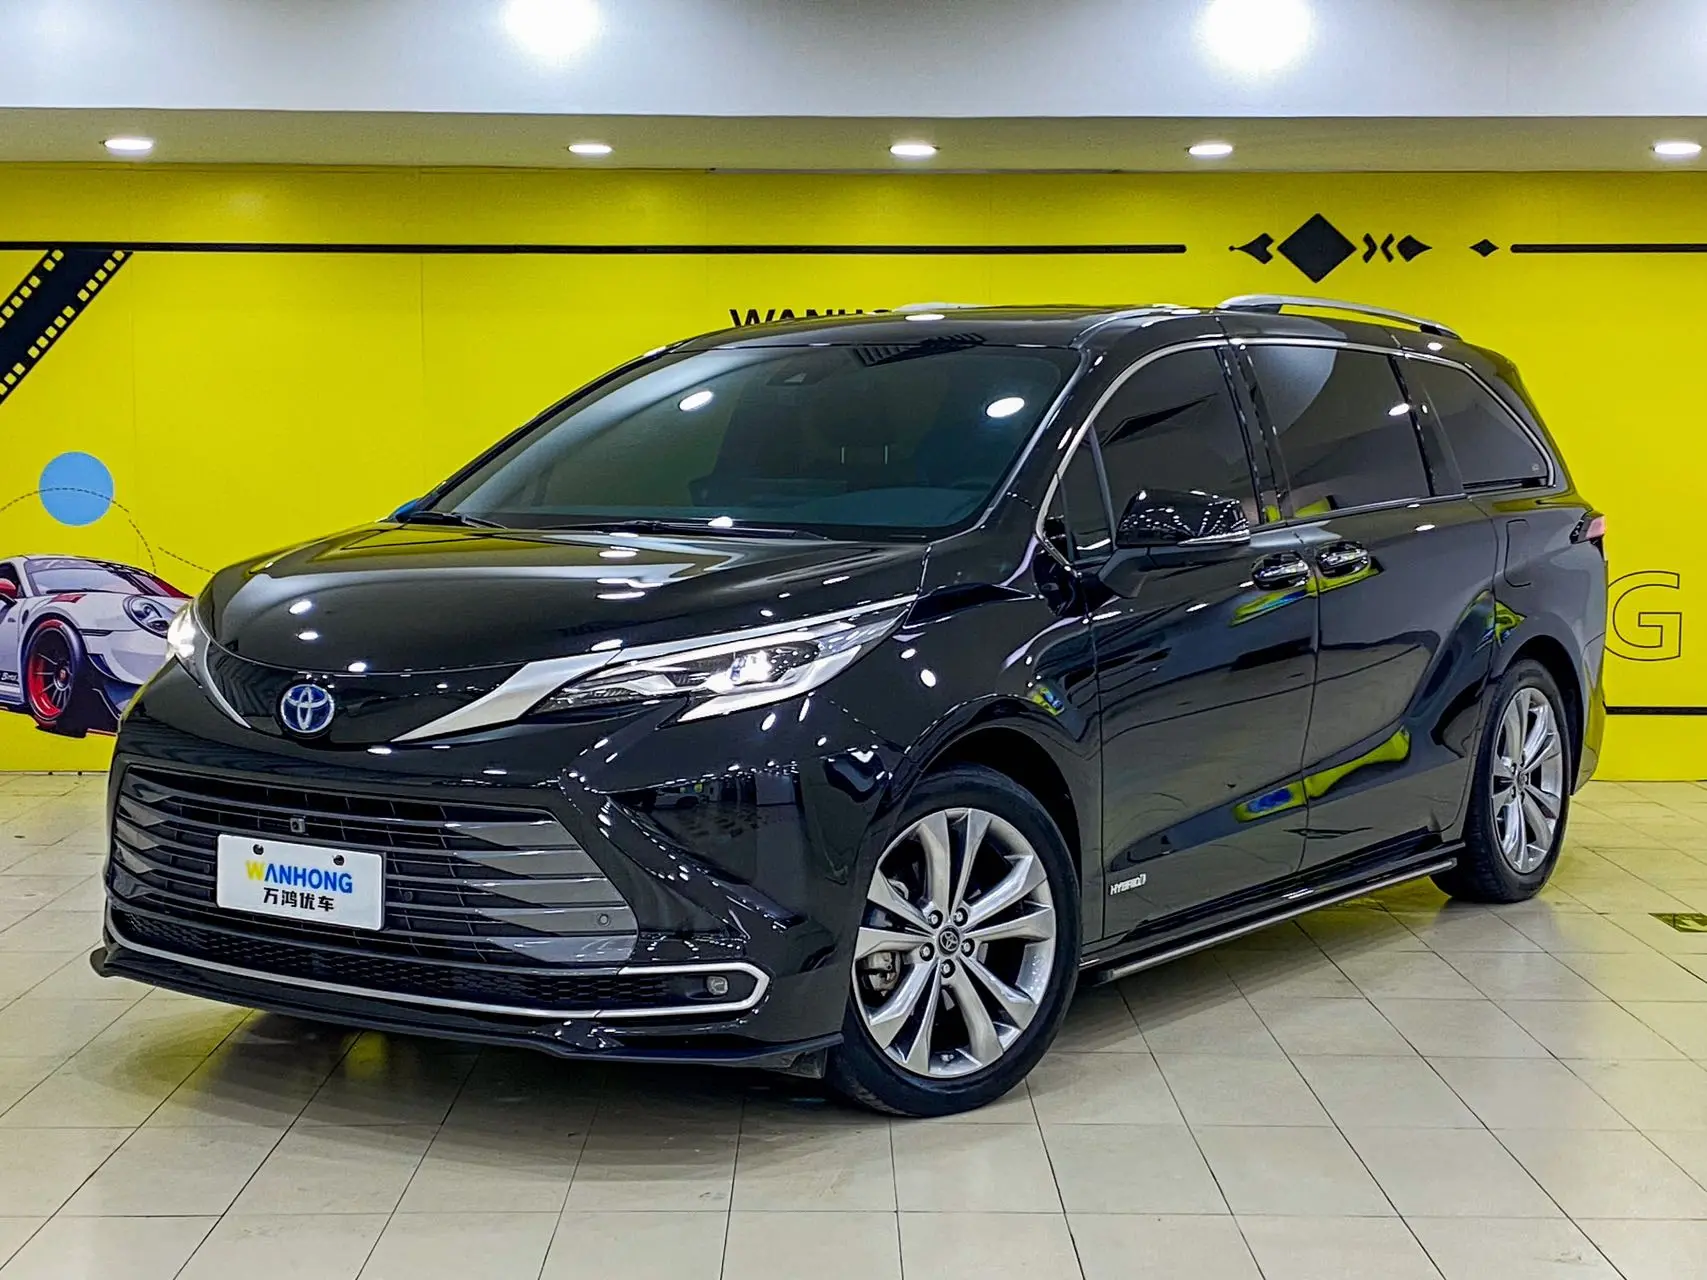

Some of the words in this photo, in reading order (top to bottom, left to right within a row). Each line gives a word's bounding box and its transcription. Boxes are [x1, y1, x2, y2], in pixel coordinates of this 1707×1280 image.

[245, 860, 353, 894] WANHONG
[263, 887, 335, 912] 万鸿优车
